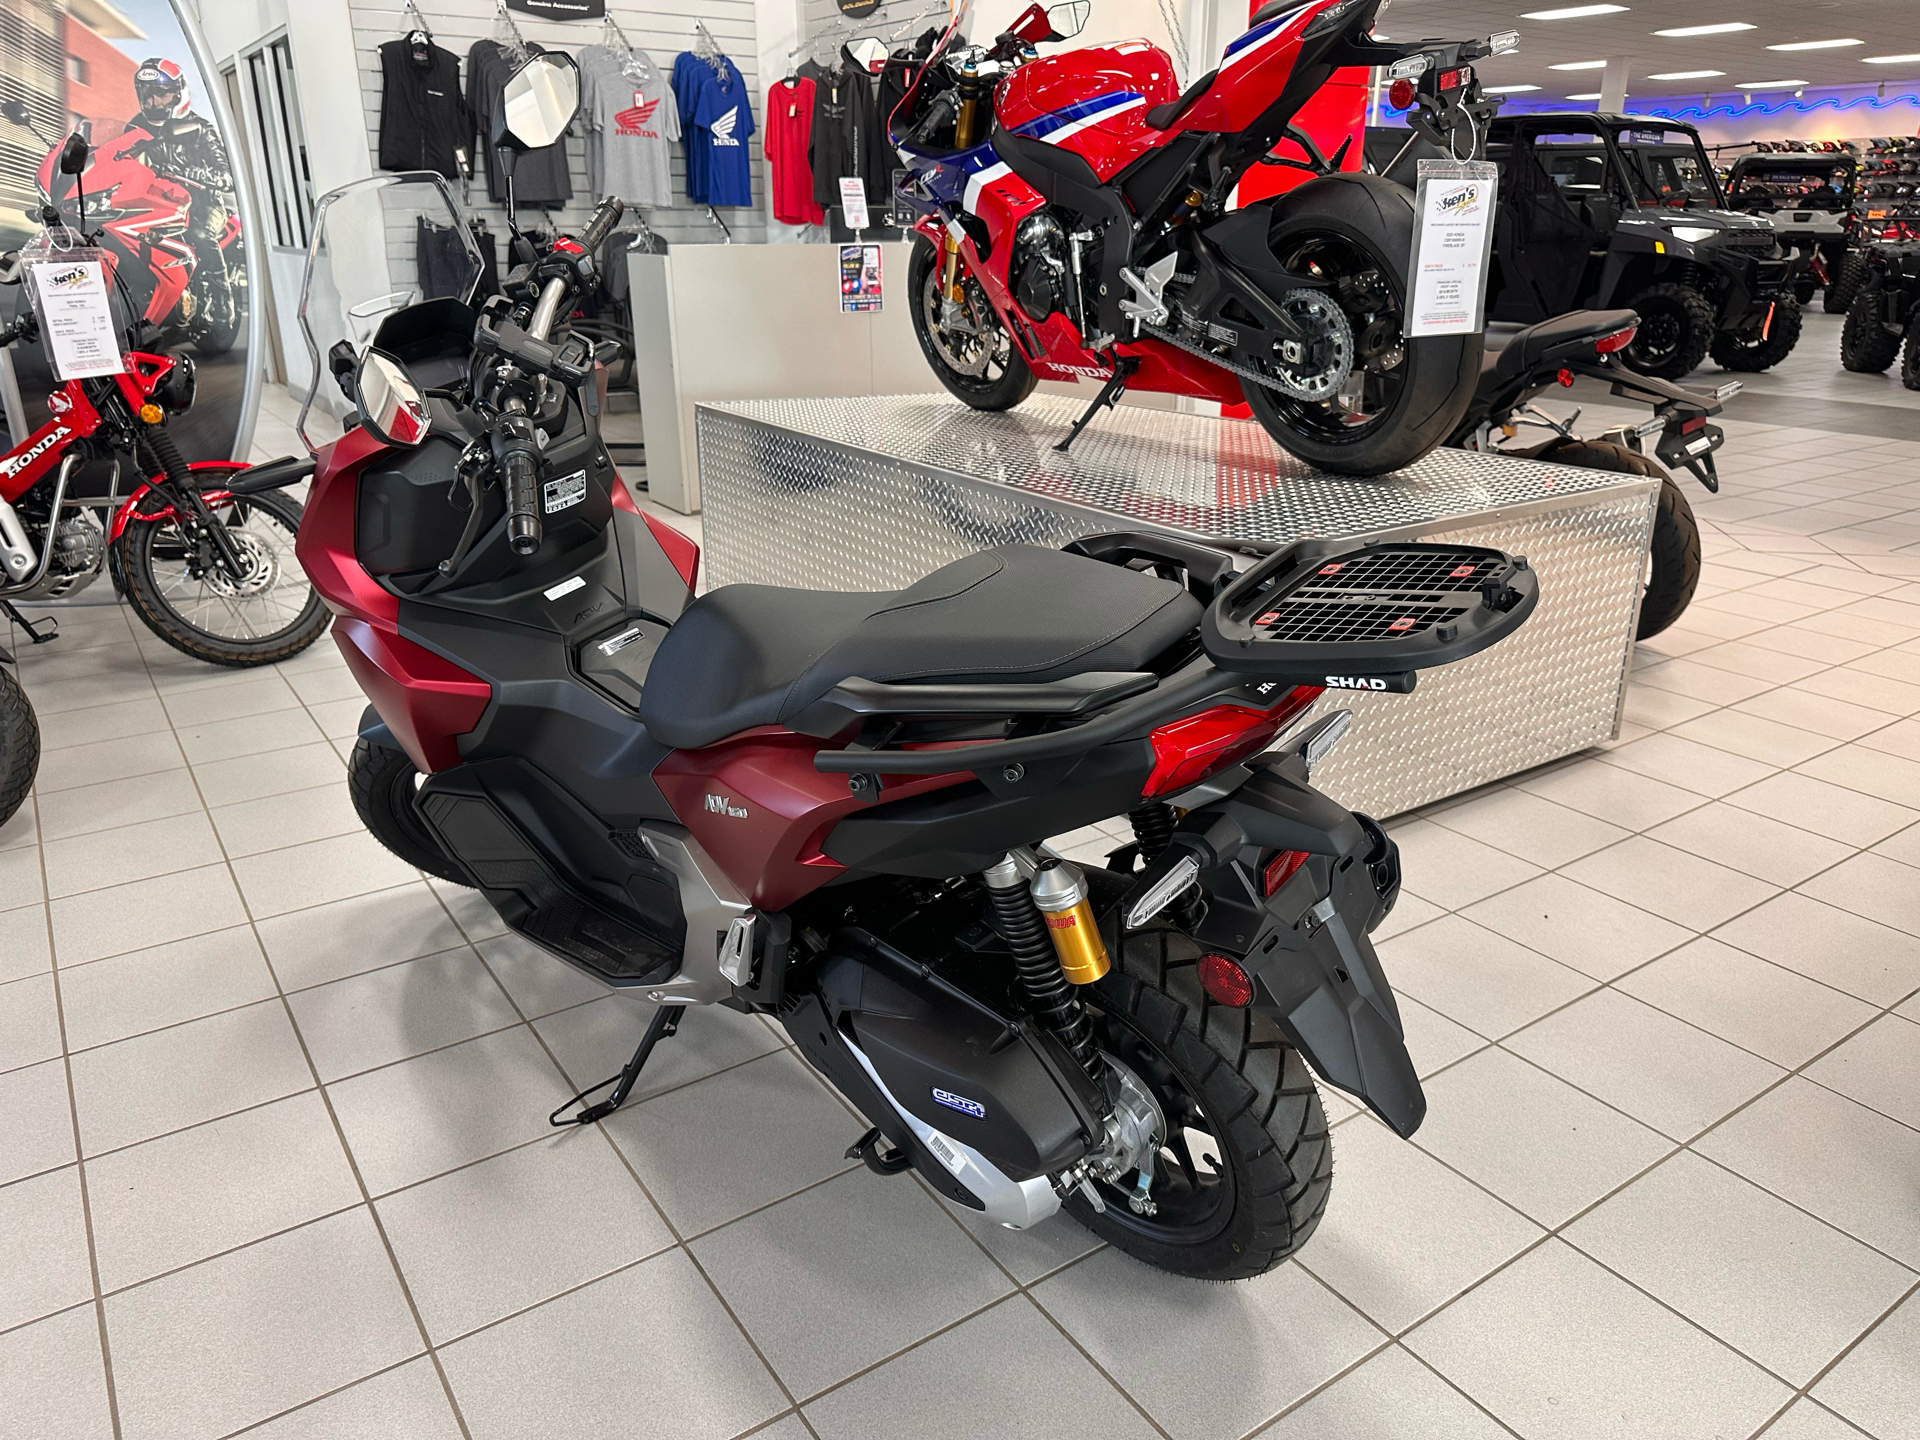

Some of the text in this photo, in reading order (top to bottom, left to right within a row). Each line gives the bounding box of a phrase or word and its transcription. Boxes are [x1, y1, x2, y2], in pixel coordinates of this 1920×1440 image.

[526, 0, 552, 8] Genuine
[614, 128, 659, 139] HONDA
[712, 138, 740, 147] HONDA
[1045, 362, 1113, 378] HONDA
[4, 426, 72, 479] HONDA
[574, 602, 603, 624] ADV
[1325, 676, 1387, 691] SHAD
